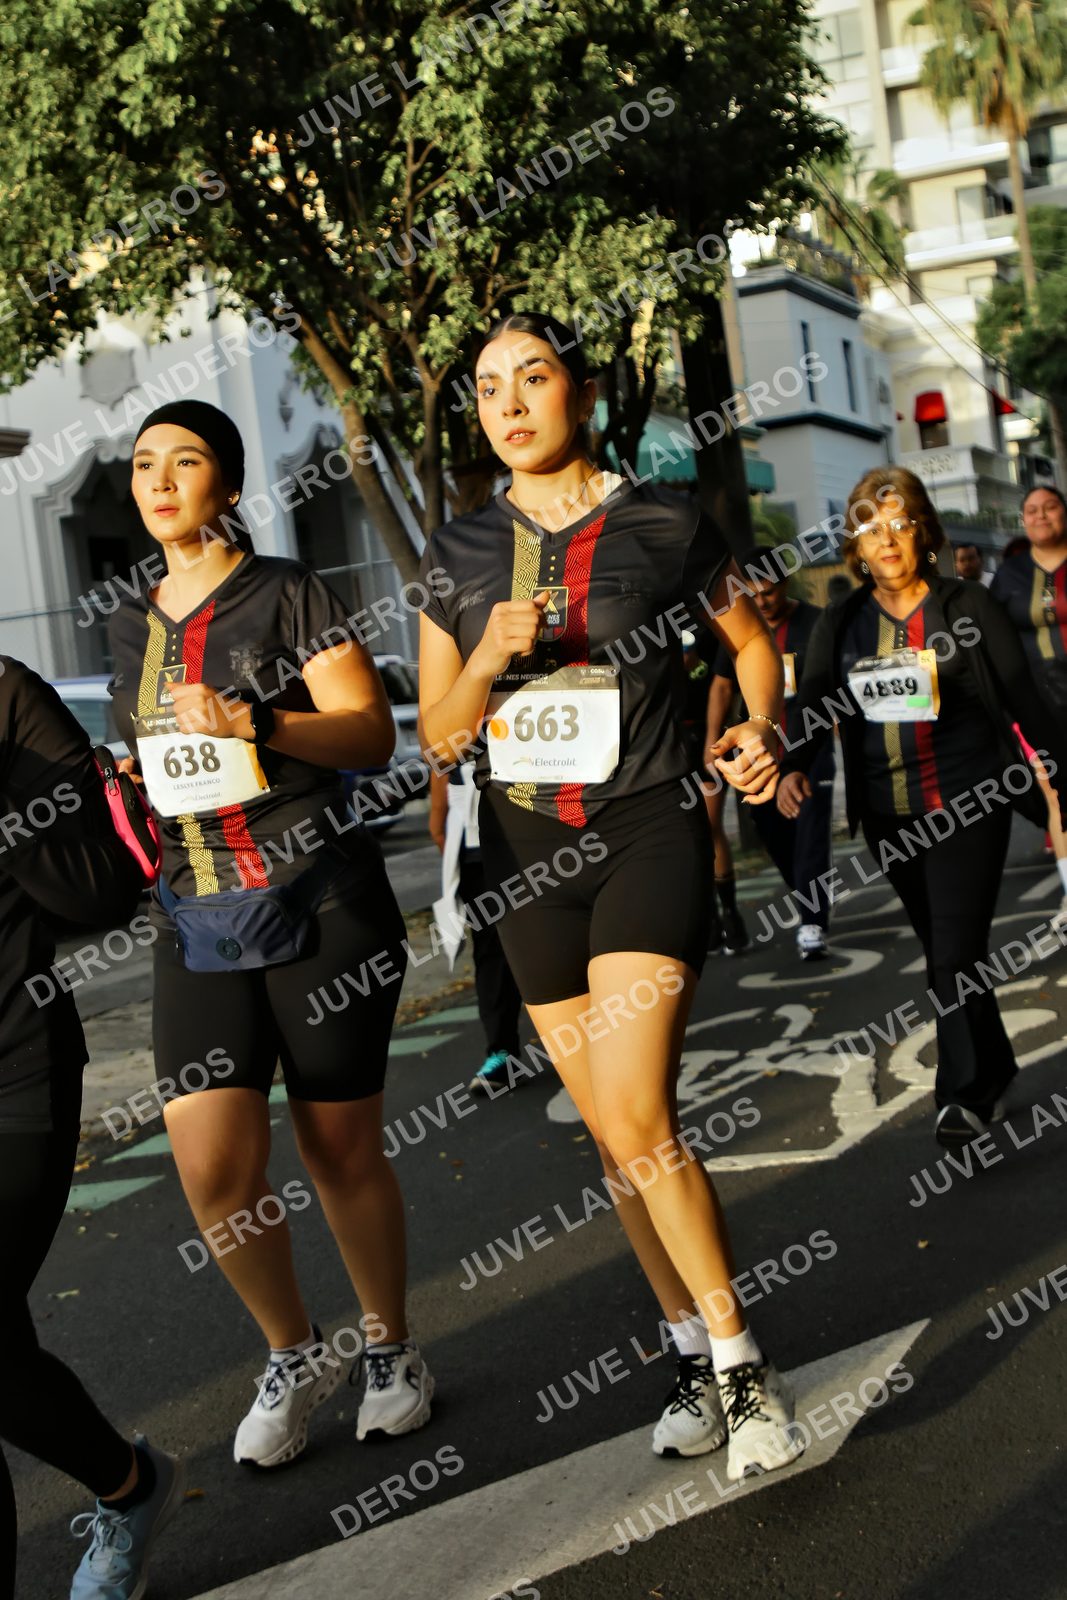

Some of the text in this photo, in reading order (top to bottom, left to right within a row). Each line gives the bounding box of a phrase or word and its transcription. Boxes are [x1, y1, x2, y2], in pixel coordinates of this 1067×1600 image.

[863, 677, 918, 698] 4889
[514, 704, 580, 742] 663
[163, 741, 221, 779] 638
[195, 778, 221, 787] FRANCO
